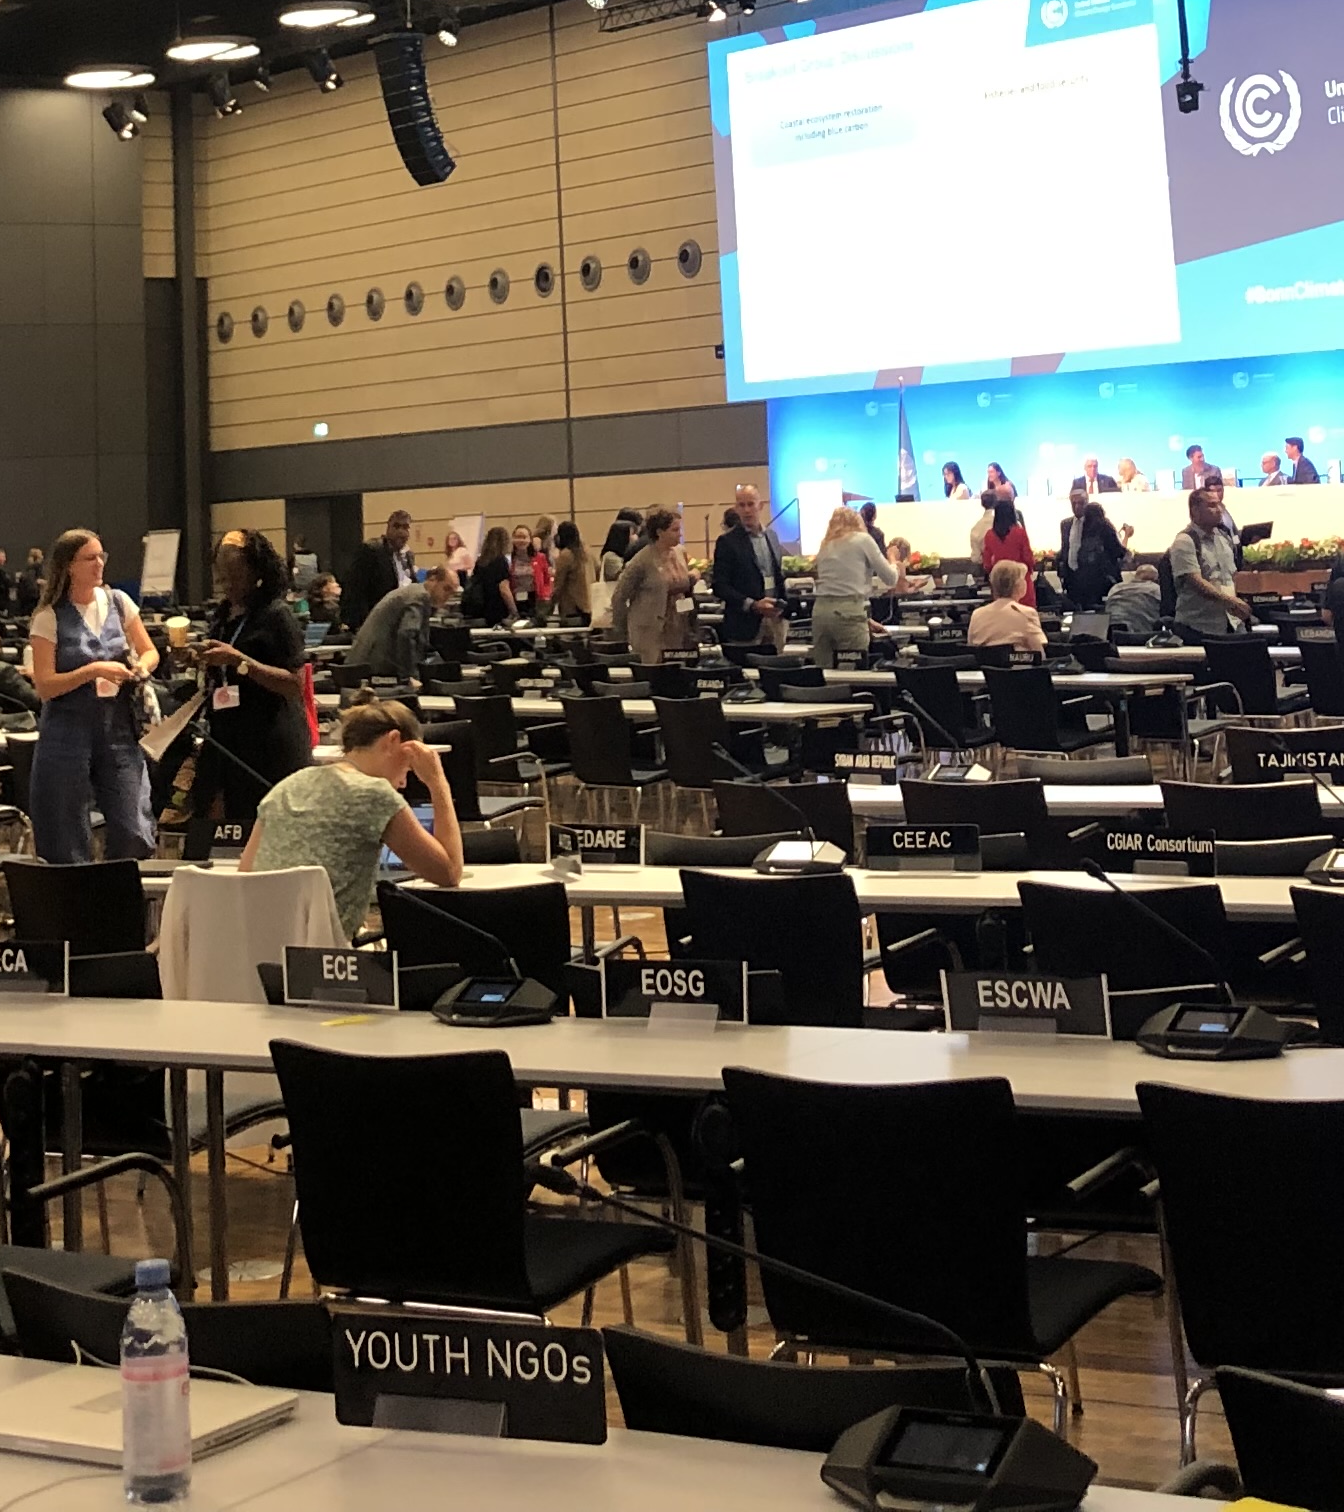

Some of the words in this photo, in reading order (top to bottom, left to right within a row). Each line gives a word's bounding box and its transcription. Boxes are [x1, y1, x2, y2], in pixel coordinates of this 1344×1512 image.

[214, 824, 243, 840] AFB
[575, 829, 626, 849] EDARE
[892, 831, 952, 849] CEEAC
[1107, 832, 1143, 851] CGIAR
[1146, 834, 1213, 854] Consortium
[322, 954, 359, 981] ECE
[641, 968, 705, 997] EOSG
[977, 979, 1072, 1010] ESCWA
[345, 1329, 470, 1377] YOUTH
[487, 1338, 592, 1384] NGOs
